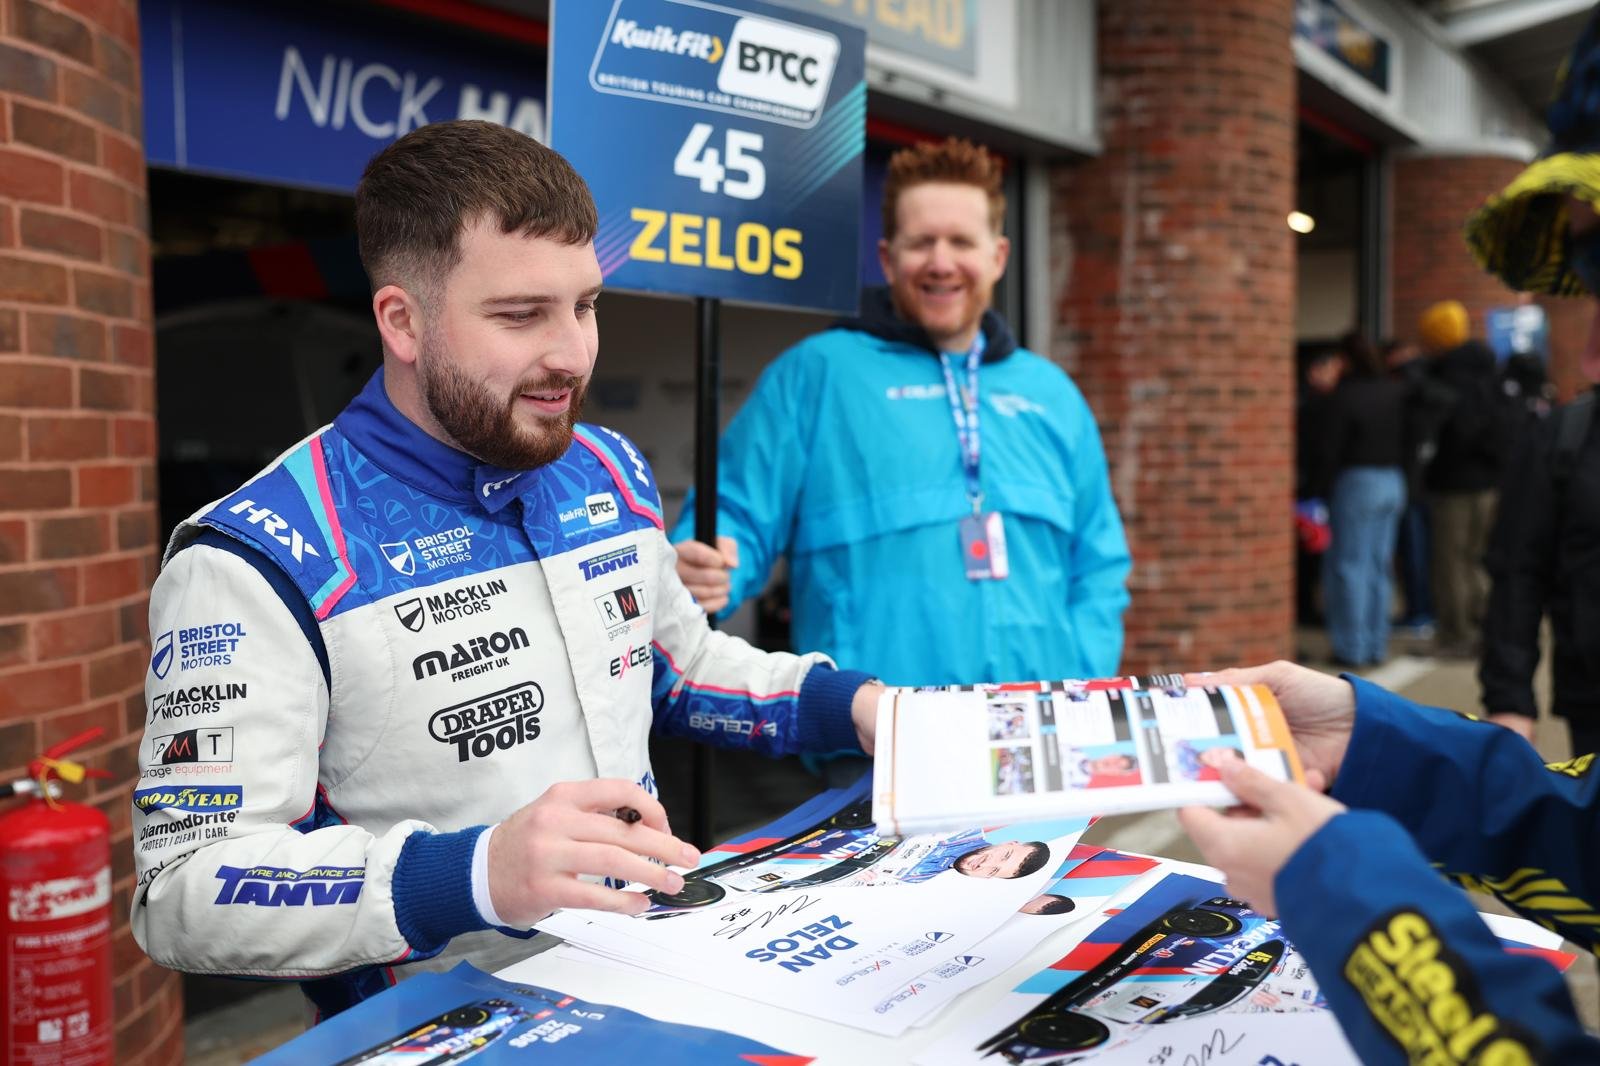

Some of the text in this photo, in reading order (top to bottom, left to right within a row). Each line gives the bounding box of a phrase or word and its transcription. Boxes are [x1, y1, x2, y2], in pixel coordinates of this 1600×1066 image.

[738, 41, 818, 87] BTCC
[275, 46, 443, 138] NICK
[674, 122, 767, 200] 45
[629, 207, 804, 281] ZELOS
[588, 501, 615, 516] BTCC
[414, 525, 474, 550] BRISTOL
[421, 538, 472, 561] STREET
[426, 552, 472, 571] MOTORS
[425, 579, 508, 613] MACKLIN
[603, 588, 646, 621] RMT
[431, 600, 491, 625] MOTORS
[179, 623, 246, 644] BRISTOL
[181, 638, 239, 659] STREET
[610, 641, 653, 679] EXCEL
[181, 654, 232, 671] MOTORS
[451, 657, 510, 682] FREIGHT UK
[164, 683, 247, 707] MACKLIN
[162, 701, 221, 720] MOTORS
[440, 689, 537, 736] DRAPER
[449, 714, 541, 762] Tools
[175, 765, 232, 778] equipment
[140, 810, 236, 842] Diamondbrite
[140, 826, 229, 852] PROTECT CLEAN CARE
[214, 865, 365, 906] TANVI
[244, 868, 273, 878] TYRE
[275, 870, 297, 880] AND
[745, 914, 853, 963] ZELOS
[777, 935, 859, 974] DAN
